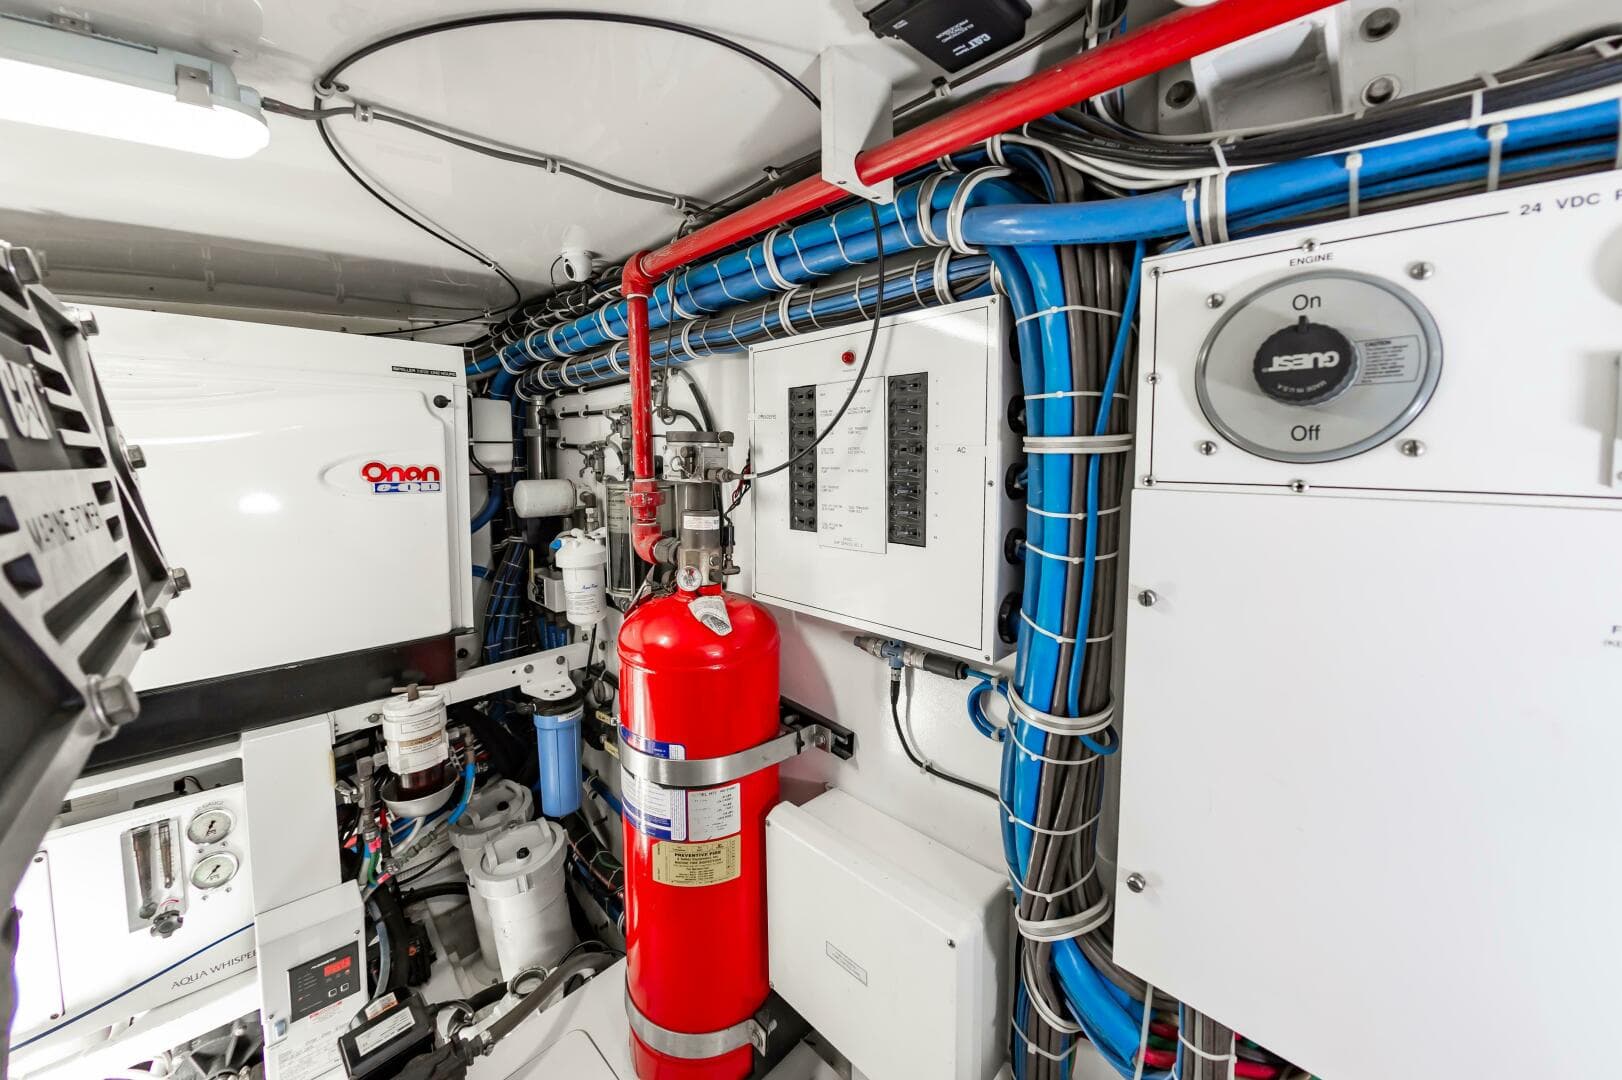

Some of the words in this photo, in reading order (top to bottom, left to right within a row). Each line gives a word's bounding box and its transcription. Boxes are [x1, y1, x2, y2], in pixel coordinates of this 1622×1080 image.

[968, 33, 991, 50] CAT
[1520, 203, 1541, 215] 24
[1556, 193, 1600, 209] VDC
[1289, 252, 1334, 266] ENGINE
[1292, 294, 1321, 311] On
[1268, 351, 1340, 372] GUEST
[1290, 425, 1320, 441] Off
[957, 446, 966, 454] AC
[361, 461, 440, 482] Onan
[171, 970, 208, 990] AQUA
